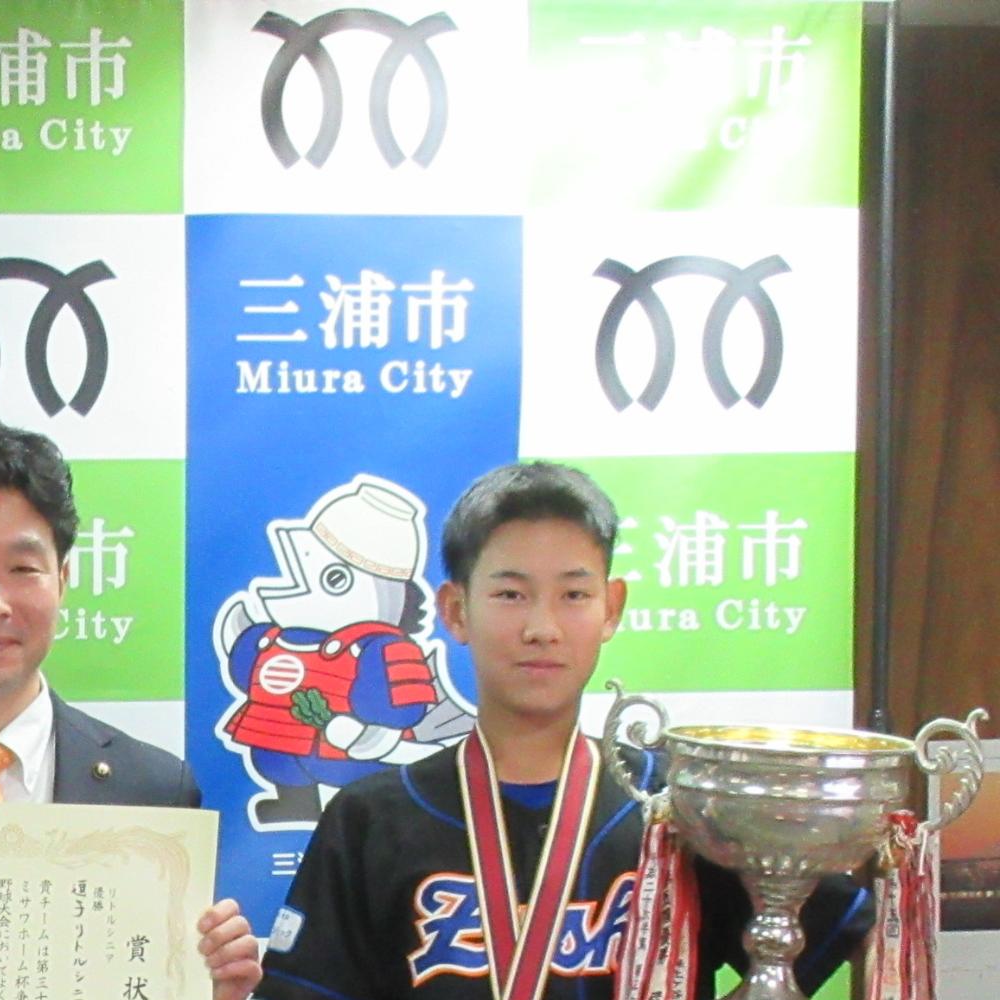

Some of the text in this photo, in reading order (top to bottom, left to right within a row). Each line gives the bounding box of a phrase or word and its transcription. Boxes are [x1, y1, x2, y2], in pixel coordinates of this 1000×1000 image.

[39, 118, 134, 156] City
[236, 269, 475, 350] 三浦市
[236, 360, 474, 398] Miura City
[715, 598, 807, 634] City
